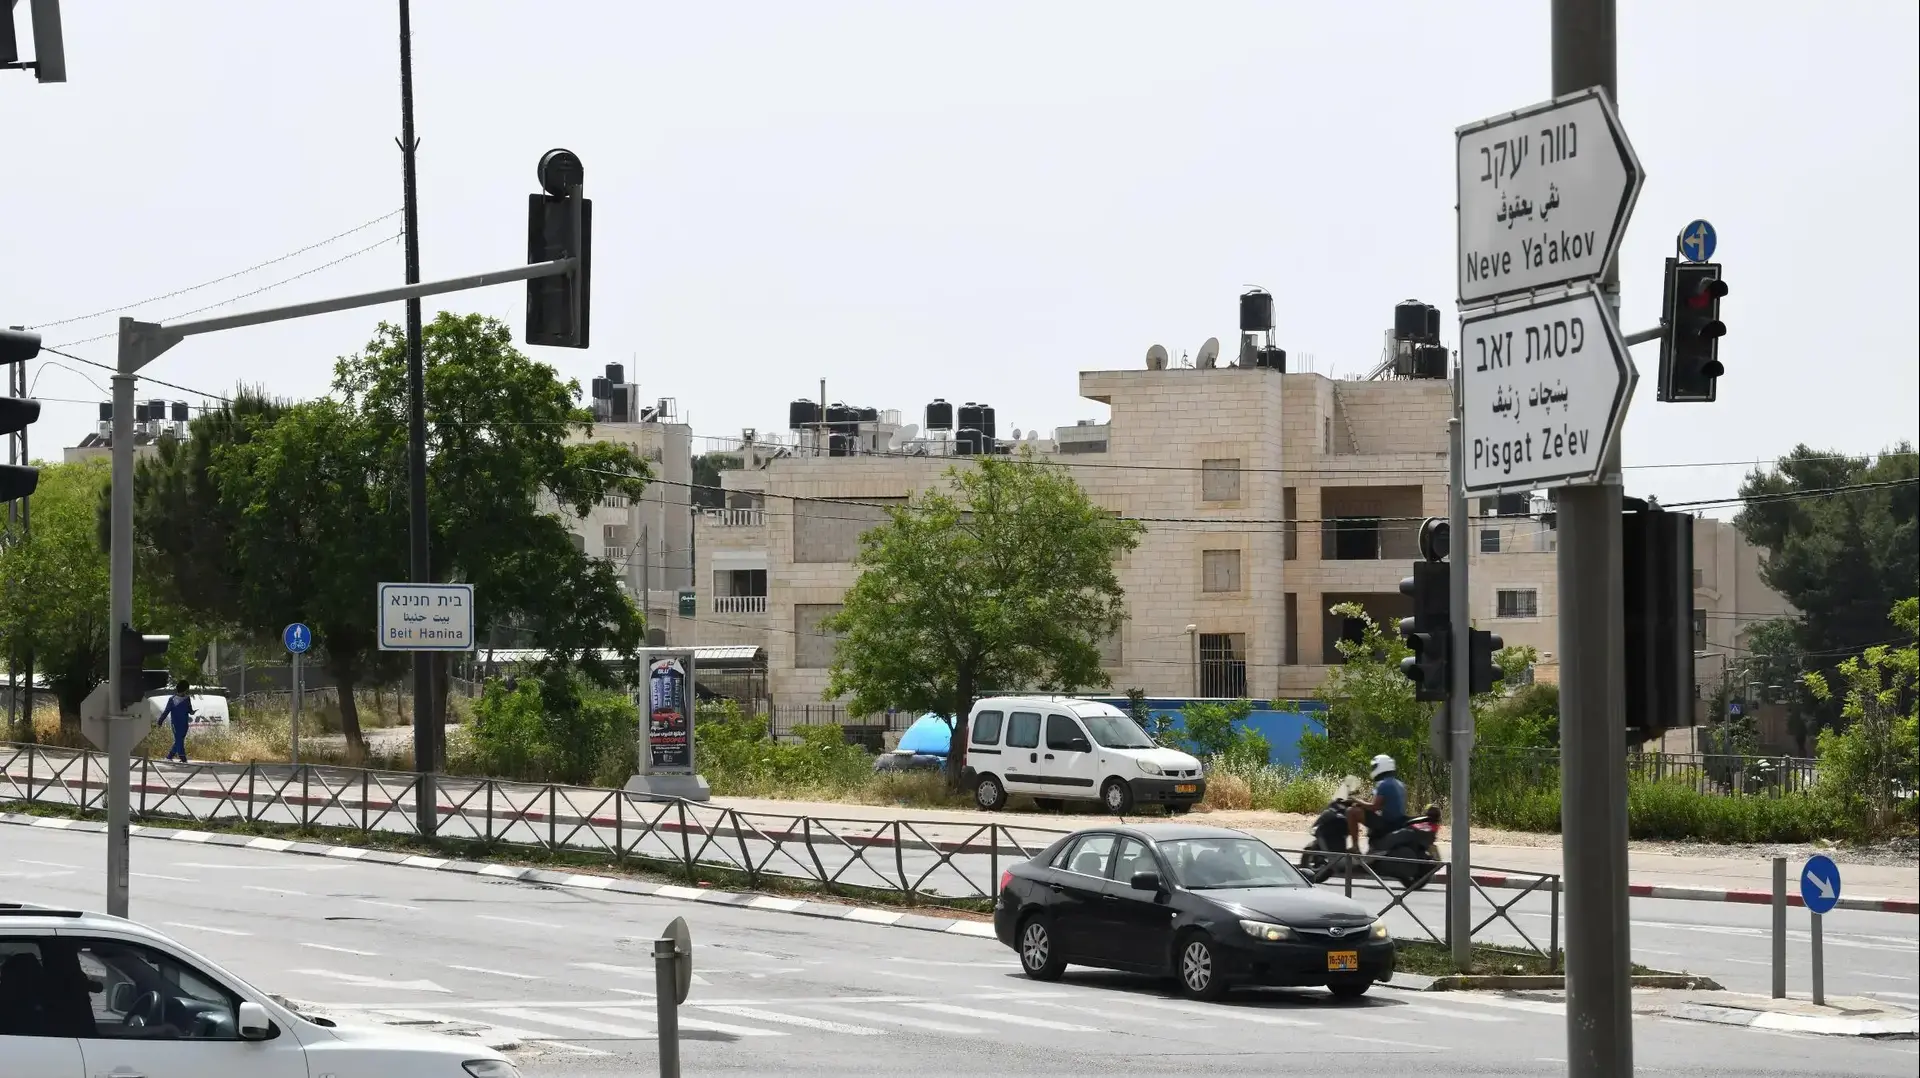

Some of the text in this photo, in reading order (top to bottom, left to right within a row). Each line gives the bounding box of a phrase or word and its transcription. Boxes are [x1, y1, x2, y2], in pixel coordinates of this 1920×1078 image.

[1480, 122, 1577, 189] נווה יעקב
[1467, 230, 1595, 283] Neve Ya'akov
[1476, 317, 1584, 372] פסגת זאב
[1474, 423, 1589, 474] Pisgat Ze'ev
[391, 595, 462, 606] בית חנינא
[403, 612, 450, 625] بيت حنينا
[390, 628, 463, 639] Beit Hanina
